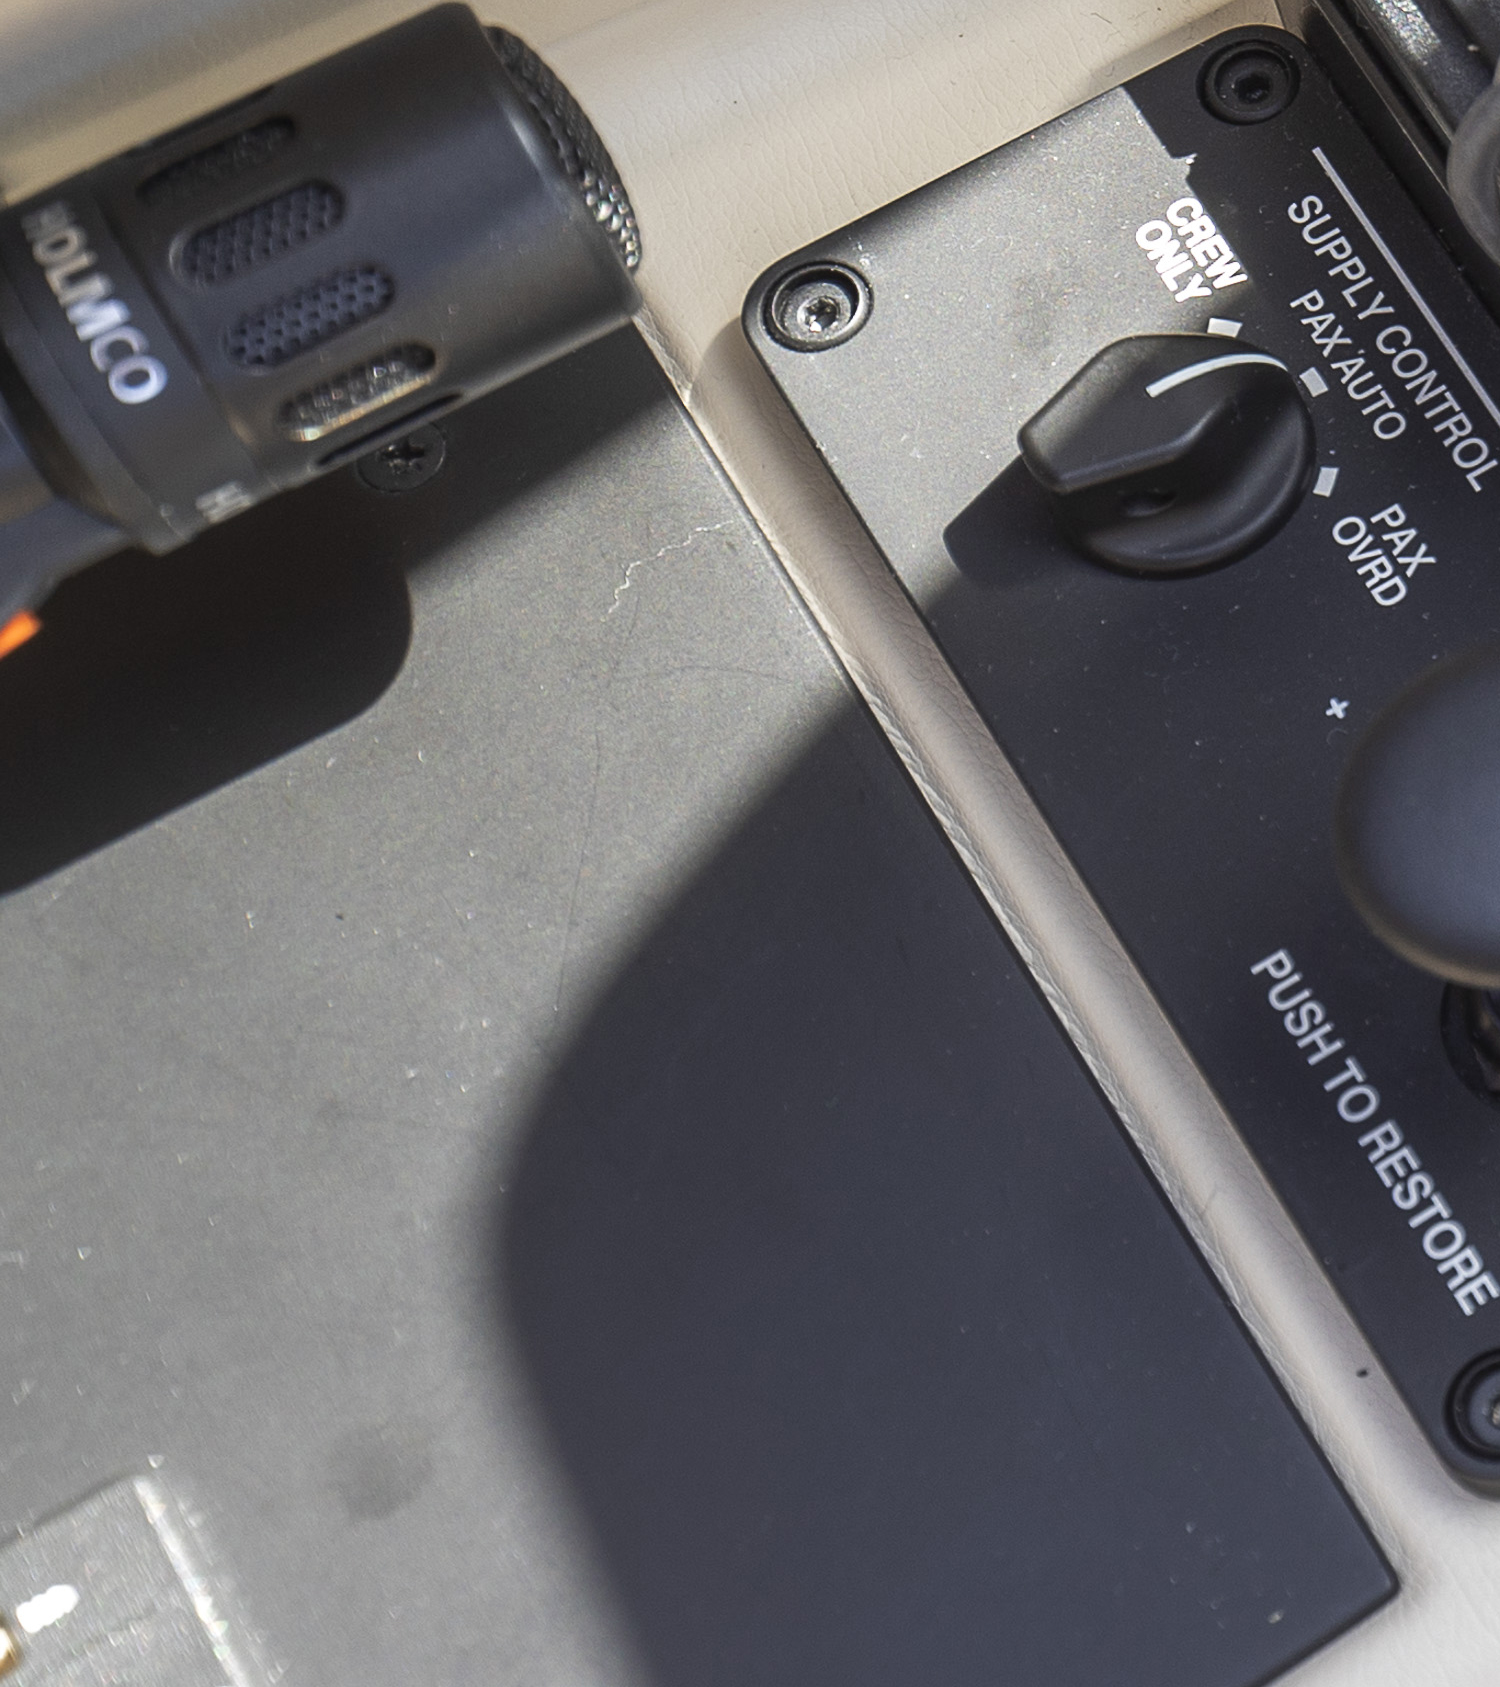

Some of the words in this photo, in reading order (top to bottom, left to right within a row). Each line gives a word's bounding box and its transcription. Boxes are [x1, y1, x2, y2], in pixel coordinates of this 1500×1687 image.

[1134, 218, 1212, 303] ONLY
[1165, 197, 1249, 291] CREW
[1288, 195, 1394, 319] SUPPLY
[1376, 325, 1498, 492] CONTROL
[1290, 289, 1352, 357] PAX
[1331, 350, 1406, 439] AUTO
[1333, 516, 1406, 605] OVRD
[1370, 504, 1436, 577] PAX
[1250, 948, 1346, 1067] PUSH
[1323, 1056, 1381, 1123] TO
